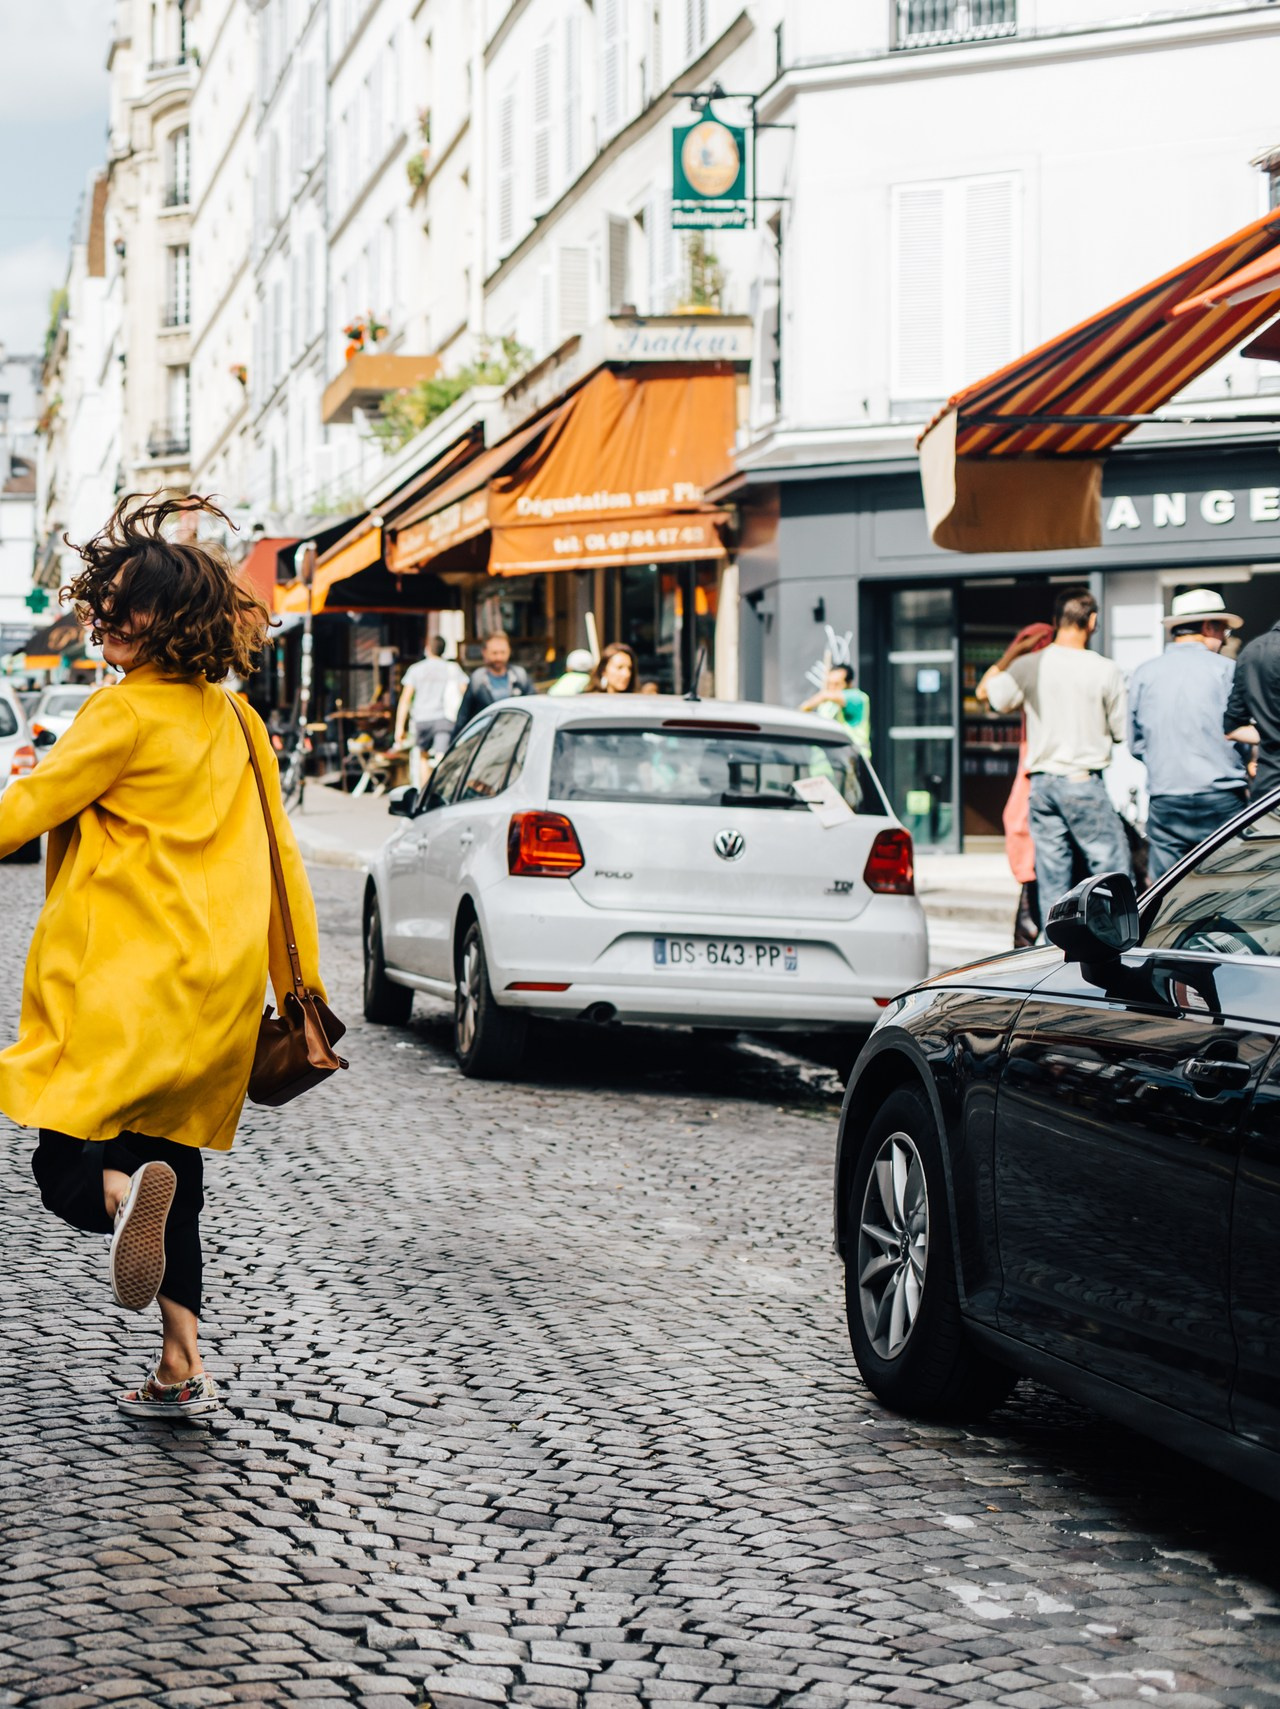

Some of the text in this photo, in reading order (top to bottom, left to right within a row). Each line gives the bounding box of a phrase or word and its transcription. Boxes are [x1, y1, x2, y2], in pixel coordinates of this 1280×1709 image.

[517, 490, 631, 519] Dégustation
[635, 488, 669, 506] sur
[594, 869, 633, 880] POLO
